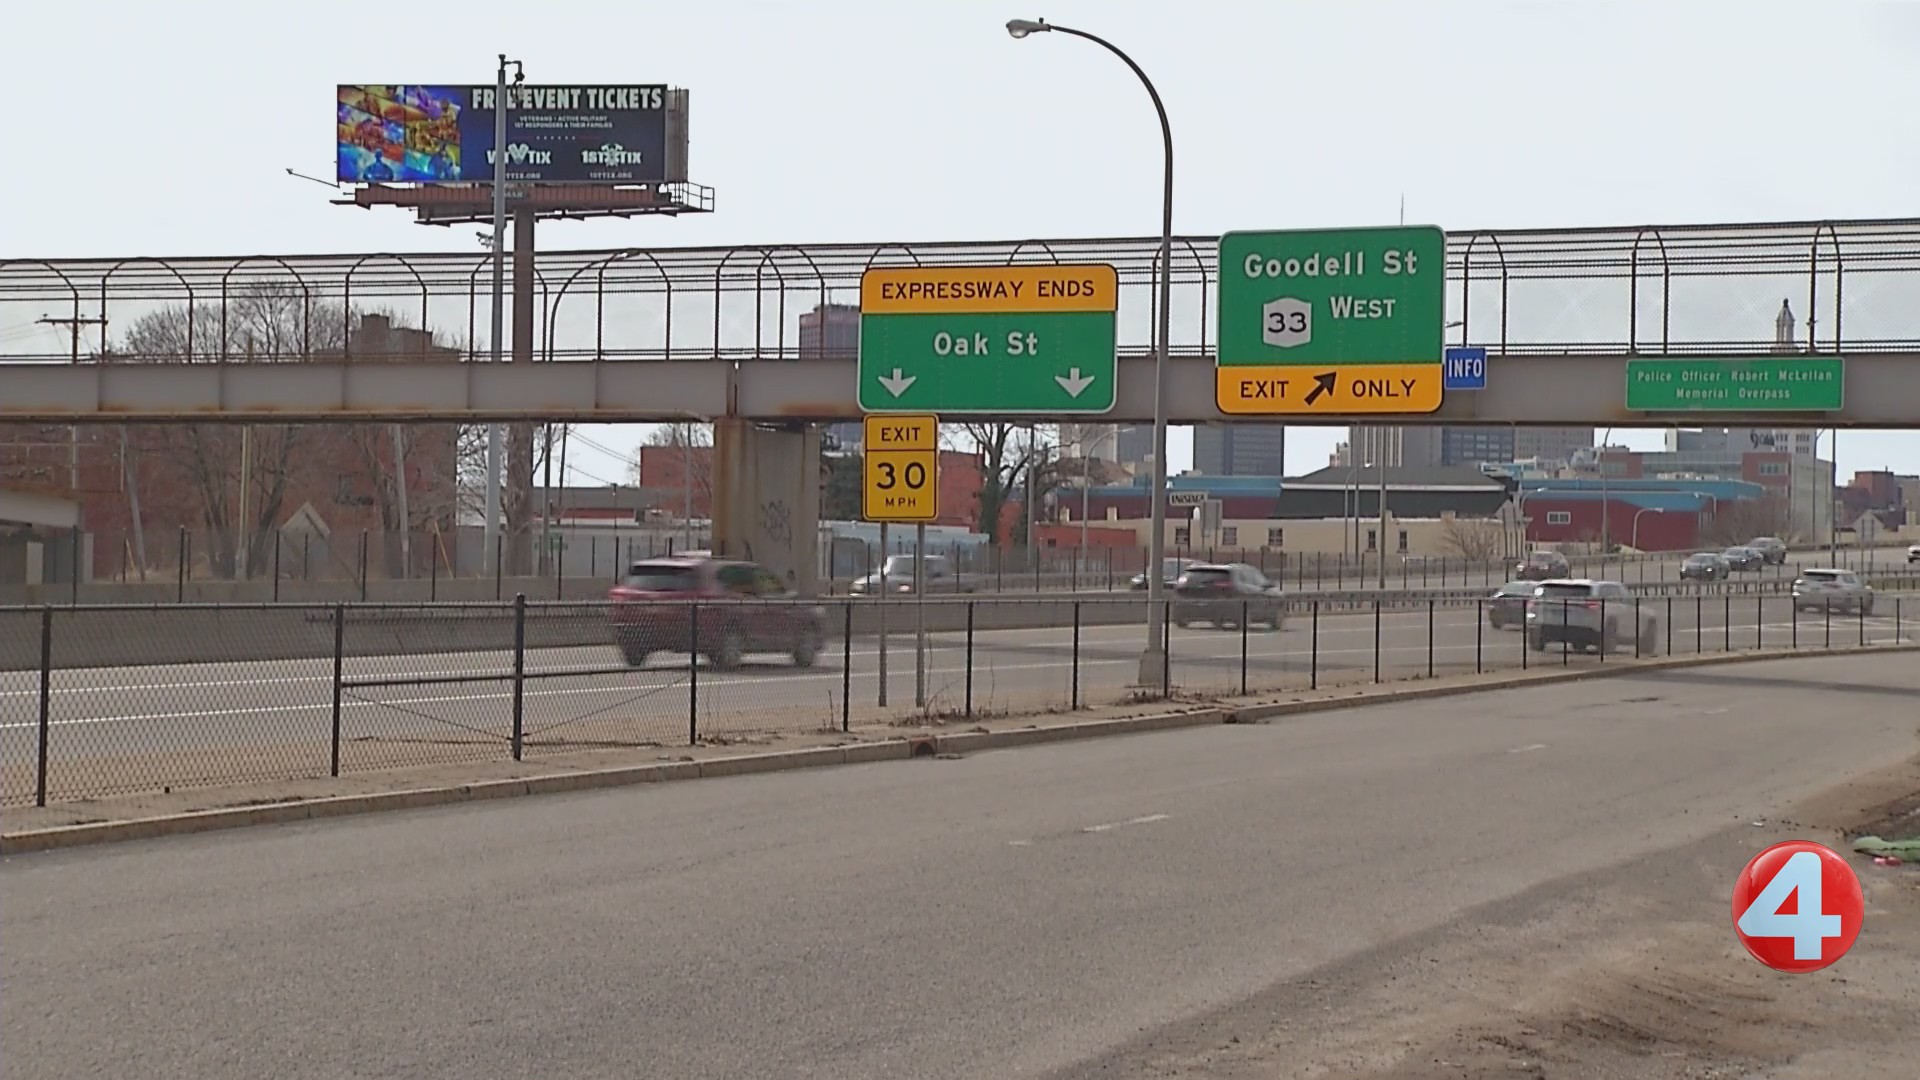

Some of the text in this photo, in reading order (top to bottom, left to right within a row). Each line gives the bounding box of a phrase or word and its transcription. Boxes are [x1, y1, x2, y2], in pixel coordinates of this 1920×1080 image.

[472, 87, 662, 110] FRE EVENT TICKETS
[1244, 250, 1417, 278] Goodell St
[882, 280, 1094, 299] EXPRESSWAY ENDS
[1267, 311, 1307, 333] 33
[934, 331, 1038, 356] Oak St
[1448, 358, 1483, 378] INFO
[1637, 370, 1832, 382] Police Officer Robert McLellan
[1240, 379, 1416, 398] EXIT ONLY
[1676, 388, 1790, 400] Memorial Overpass
[881, 427, 921, 441] EXIT
[876, 462, 926, 489] 30
[885, 497, 916, 507] MPH
